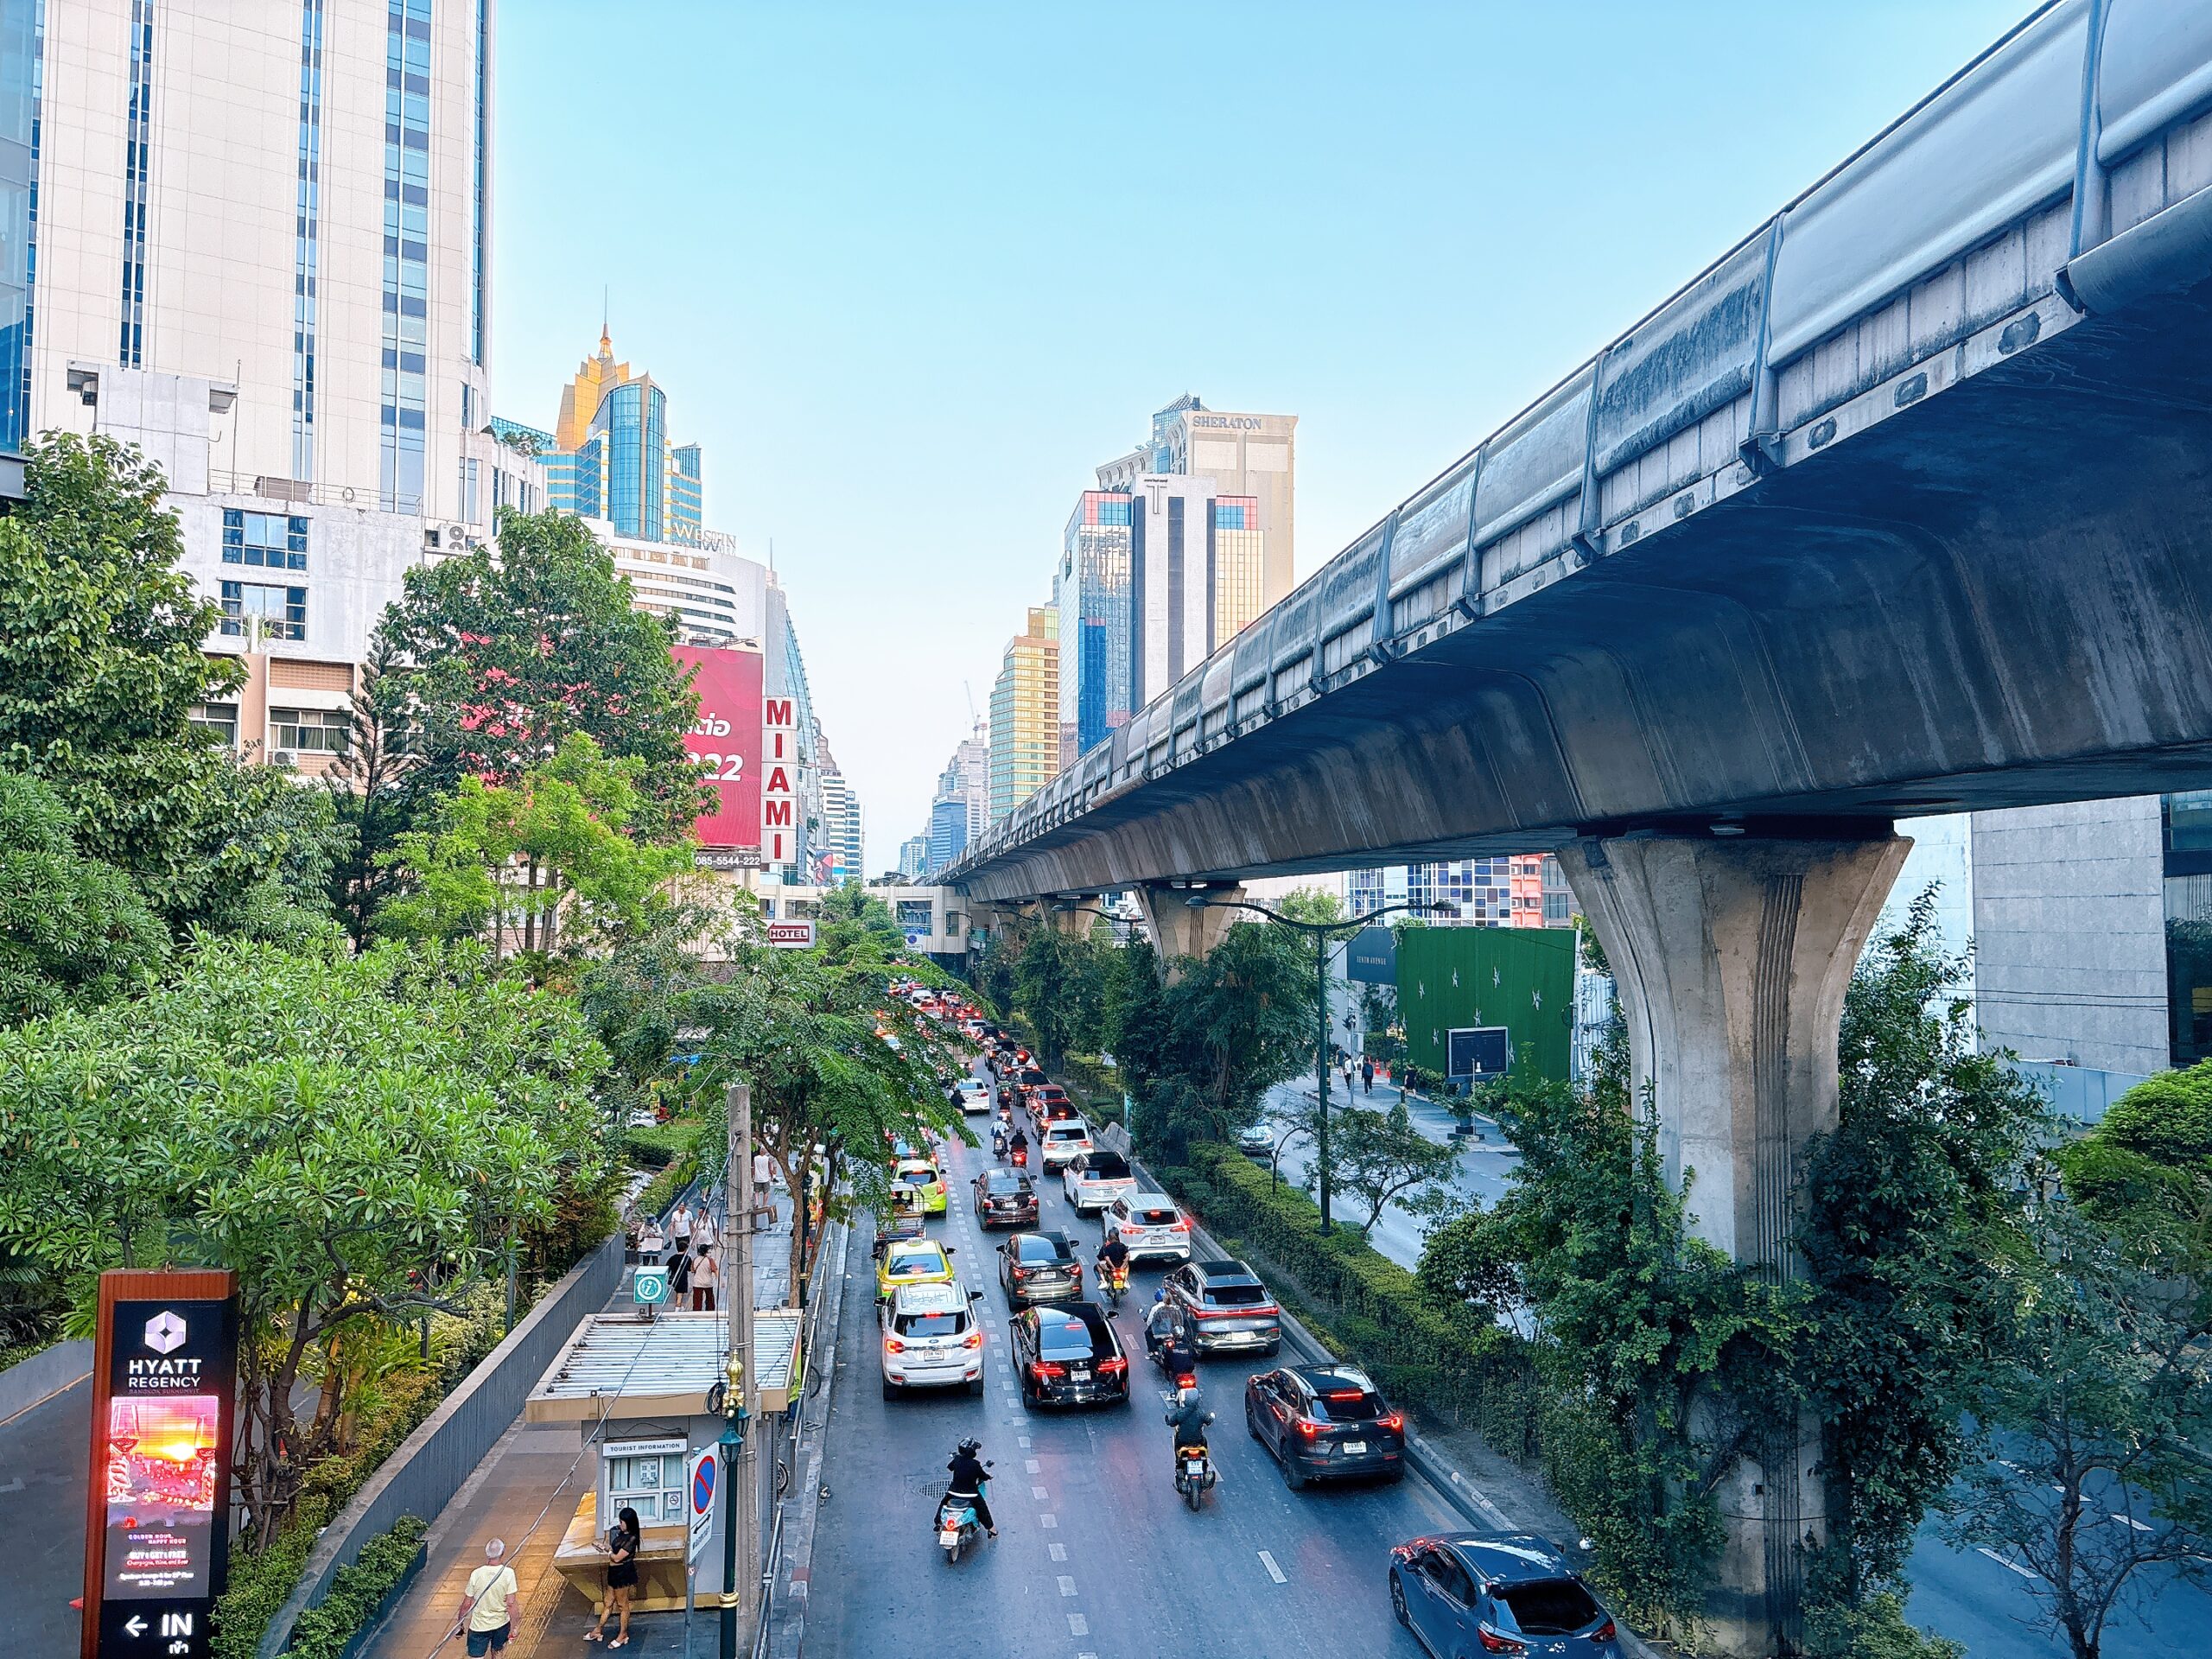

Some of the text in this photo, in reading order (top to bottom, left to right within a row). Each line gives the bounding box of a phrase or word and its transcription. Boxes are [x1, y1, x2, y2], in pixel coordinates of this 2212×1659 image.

[1192, 416, 1262, 429] SHERATON
[674, 522, 736, 549] WESTIN
[766, 700, 791, 860] MIAMI
[695, 856, 760, 865] 085-5544-222
[129, 1359, 201, 1374] HYATT
[128, 1376, 200, 1388] REGENCY
[162, 1613, 193, 1637] IN
